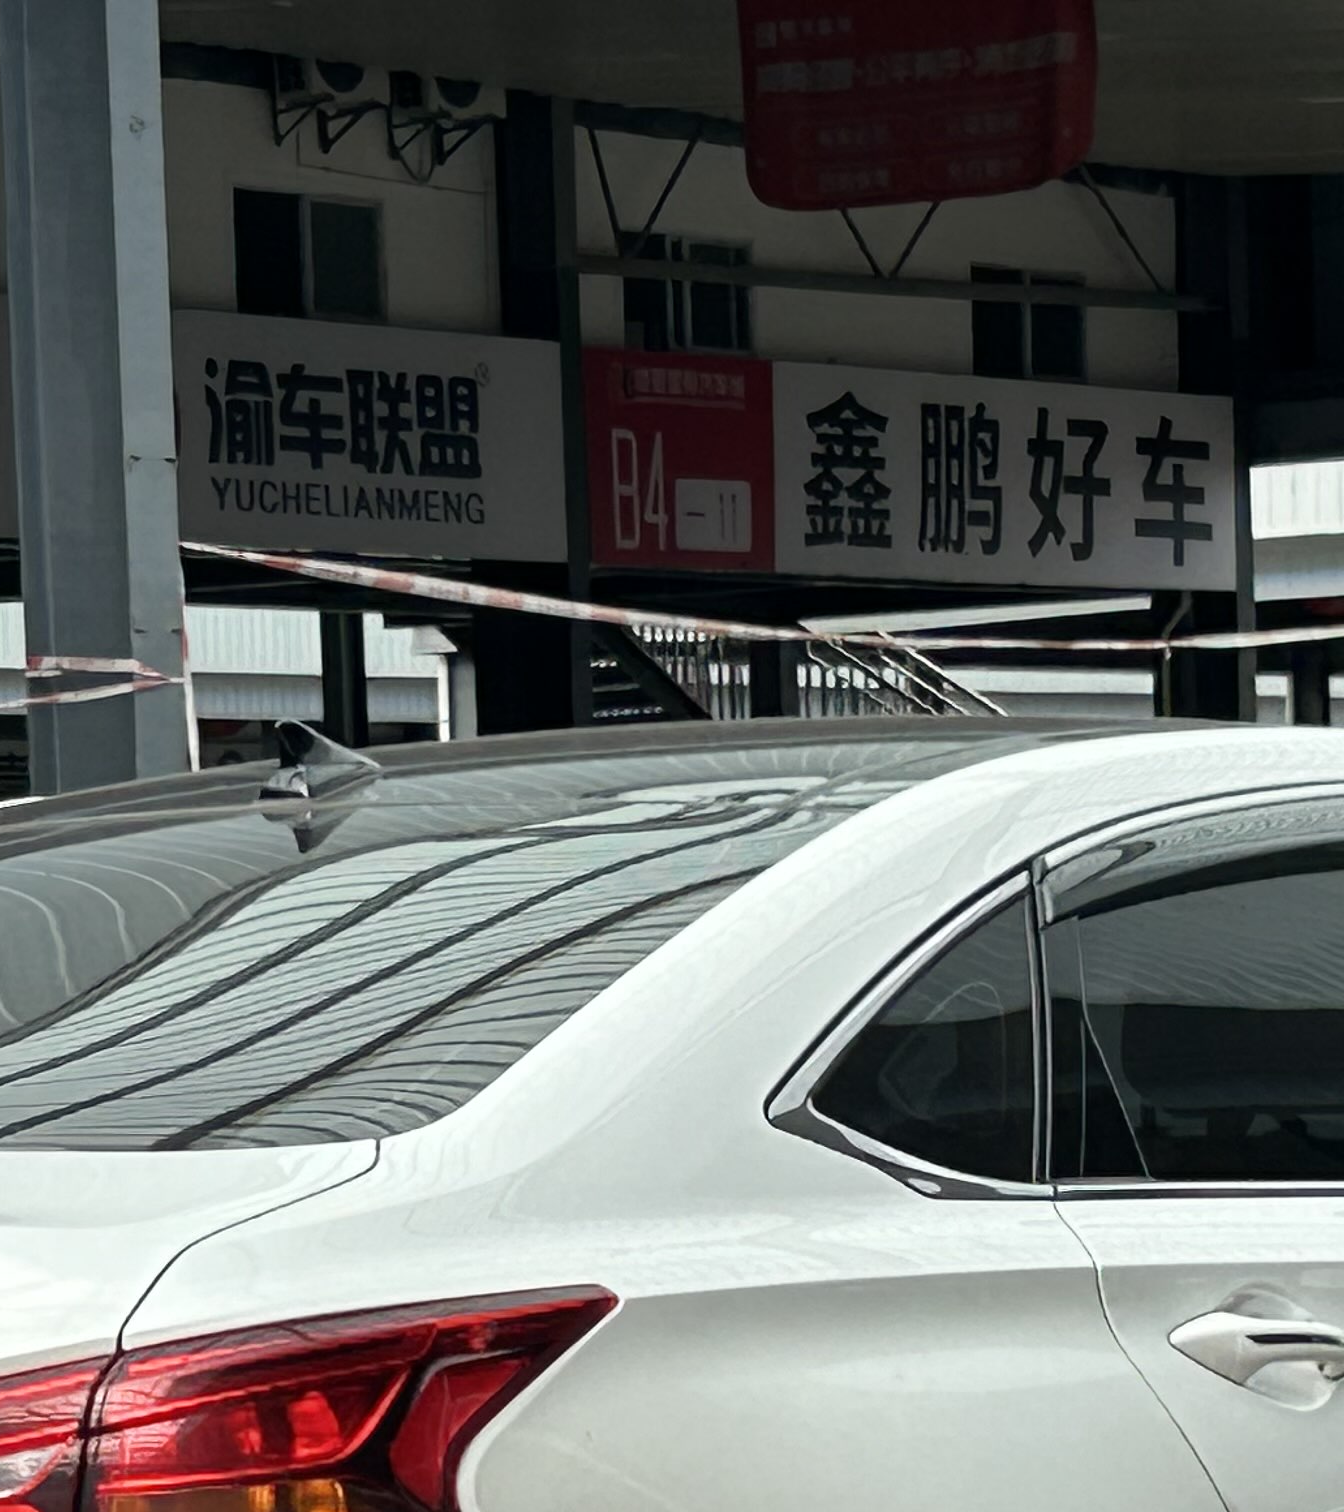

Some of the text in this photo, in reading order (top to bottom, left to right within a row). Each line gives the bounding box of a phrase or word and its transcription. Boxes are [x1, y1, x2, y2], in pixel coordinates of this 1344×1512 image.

[204, 357, 482, 478] 渝车联盟
[210, 476, 486, 525] YUCHELIANMENG
[803, 391, 1213, 566] 鑫鹏好车
